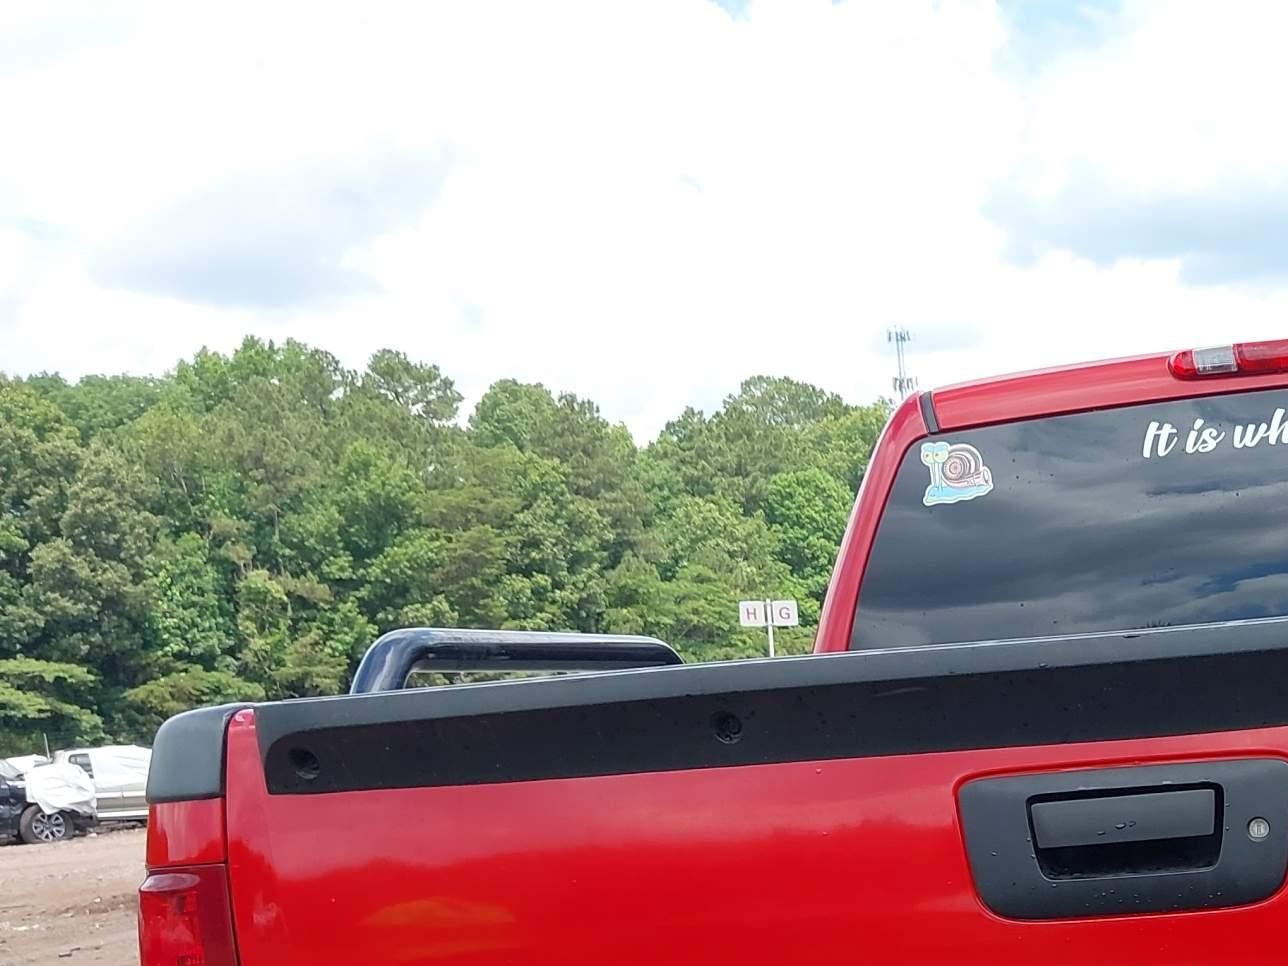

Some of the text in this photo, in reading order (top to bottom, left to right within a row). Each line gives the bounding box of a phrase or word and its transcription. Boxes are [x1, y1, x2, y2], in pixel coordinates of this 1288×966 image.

[1142, 420, 1178, 458] It
[1185, 418, 1225, 454] is
[746, 607, 757, 620] H
[779, 606, 791, 620] G
